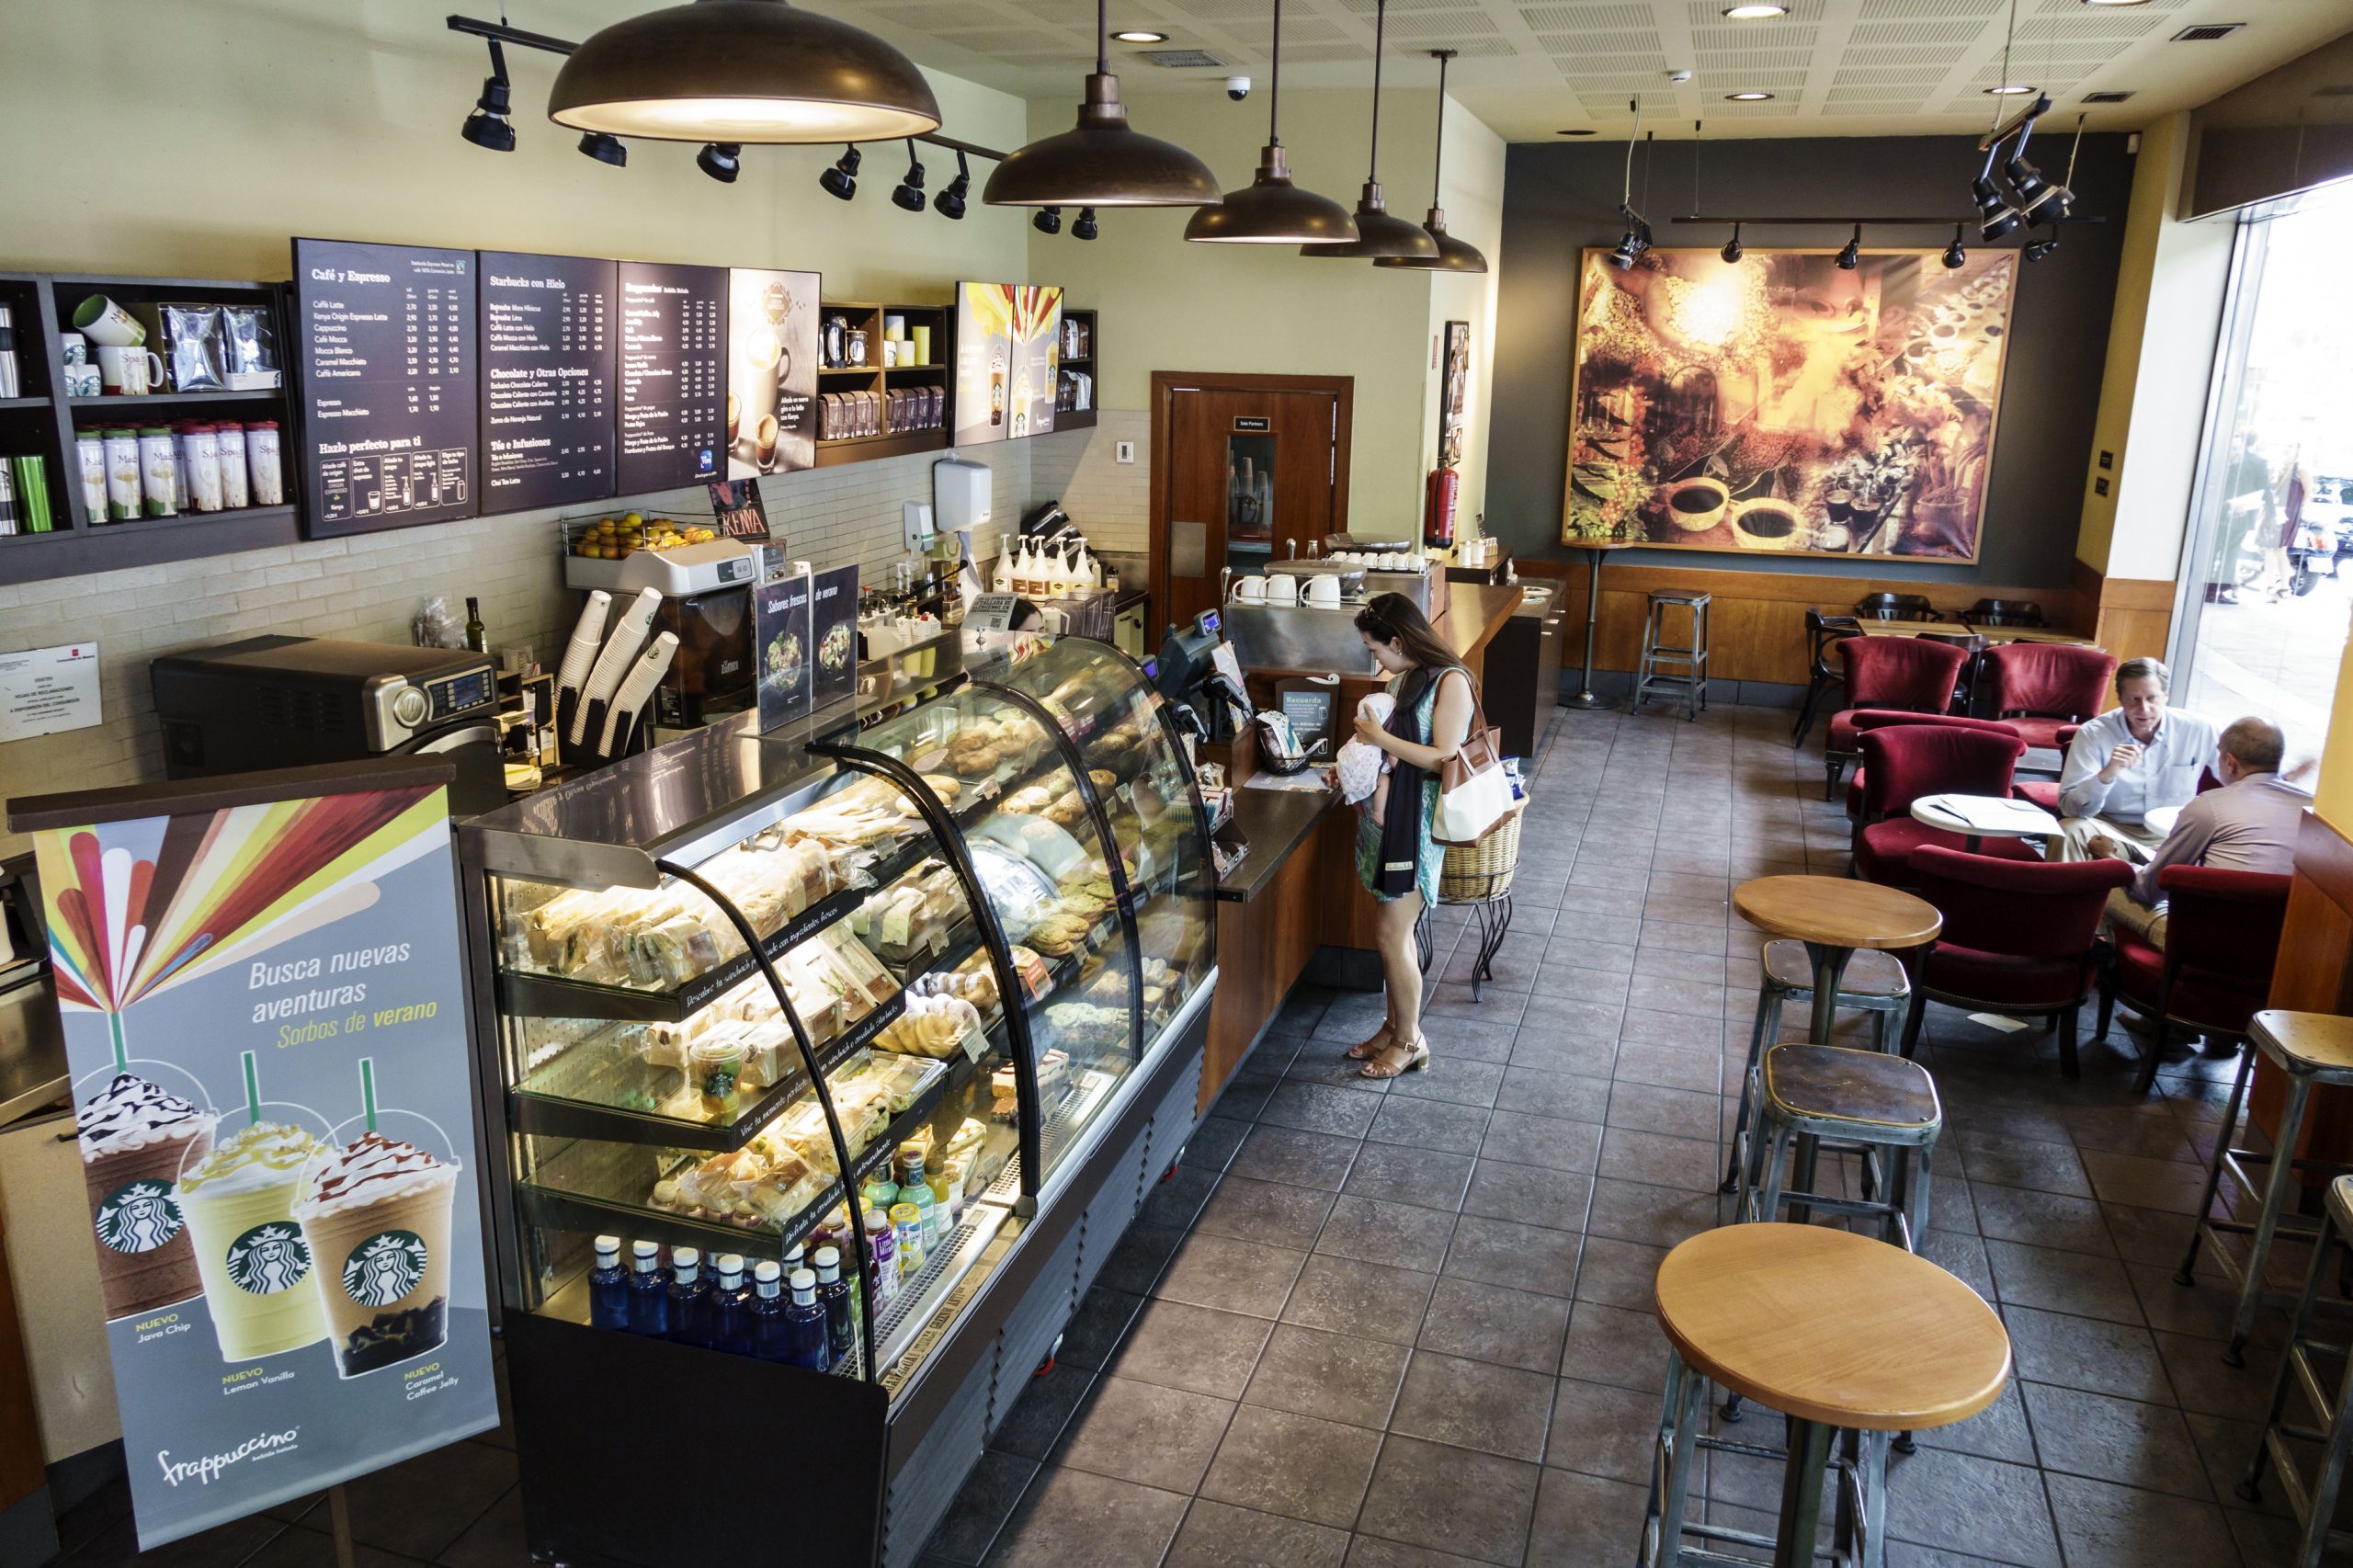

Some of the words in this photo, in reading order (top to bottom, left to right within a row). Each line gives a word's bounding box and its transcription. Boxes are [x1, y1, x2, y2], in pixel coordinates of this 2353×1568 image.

[312, 268, 335, 281] Café
[337, 272, 345, 283] y
[347, 270, 391, 284] Espresso
[490, 276, 530, 287] Starbucks
[531, 280, 544, 289] con
[546, 279, 566, 289] Hielo
[313, 312, 331, 322] Kenya
[331, 312, 349, 322] Origin
[349, 312, 373, 322] Espresso
[314, 324, 347, 333] Cappuccino
[335, 347, 353, 355] Blanco
[491, 369, 528, 379] Chocolate
[529, 369, 535, 379] y
[536, 368, 557, 377] Otras
[557, 368, 588, 379] Opciones
[317, 399, 342, 408] Espresso
[317, 410, 342, 419] Espresso
[342, 408, 369, 416] Macchiato
[318, 441, 347, 454] Hazlo
[348, 439, 388, 454] perfecto
[390, 438, 412, 450] para
[412, 436, 421, 447] ti
[491, 439, 506, 450] Tés
[506, 441, 511, 449] e
[513, 437, 551, 449] Infusiones
[722, 509, 767, 536] KENYA
[814, 588, 822, 601] de
[822, 585, 838, 599] verano
[767, 597, 789, 614] Sabores
[790, 592, 808, 608] frescos
[248, 957, 321, 990] Busca
[330, 942, 411, 973] nuevas
[686, 983, 715, 1007] Descubre
[715, 976, 723, 987] tu
[779, 937, 790, 949] con
[789, 918, 820, 945] ingredientes
[820, 906, 838, 925] frescos
[252, 983, 367, 1024] aventuras
[278, 1019, 338, 1048] Sorbos
[345, 1011, 366, 1033] de
[373, 1001, 438, 1028] verano
[740, 1123, 754, 1138] Vive
[754, 1116, 762, 1124] tu
[762, 1094, 786, 1119] momento
[855, 1023, 875, 1044] ensalada
[875, 1005, 899, 1028] Starbucks
[785, 1219, 809, 1244] Disfruta
[809, 1208, 816, 1219] tu
[816, 1187, 840, 1213] ensalada
[857, 1138, 892, 1175] artesanalmente
[135, 1313, 178, 1333] NUEVO
[137, 1330, 164, 1343] Java
[165, 1322, 191, 1337] Chip
[222, 1367, 264, 1385] NUEVO
[404, 1362, 440, 1381] NUEVO
[405, 1370, 444, 1391] Caramel
[223, 1380, 259, 1395] Lemon
[260, 1370, 295, 1385] Vanilla
[406, 1385, 437, 1401] Coffee
[439, 1377, 460, 1391] Jelly
[252, 1449, 276, 1461] bebida
[276, 1444, 299, 1456] helada
